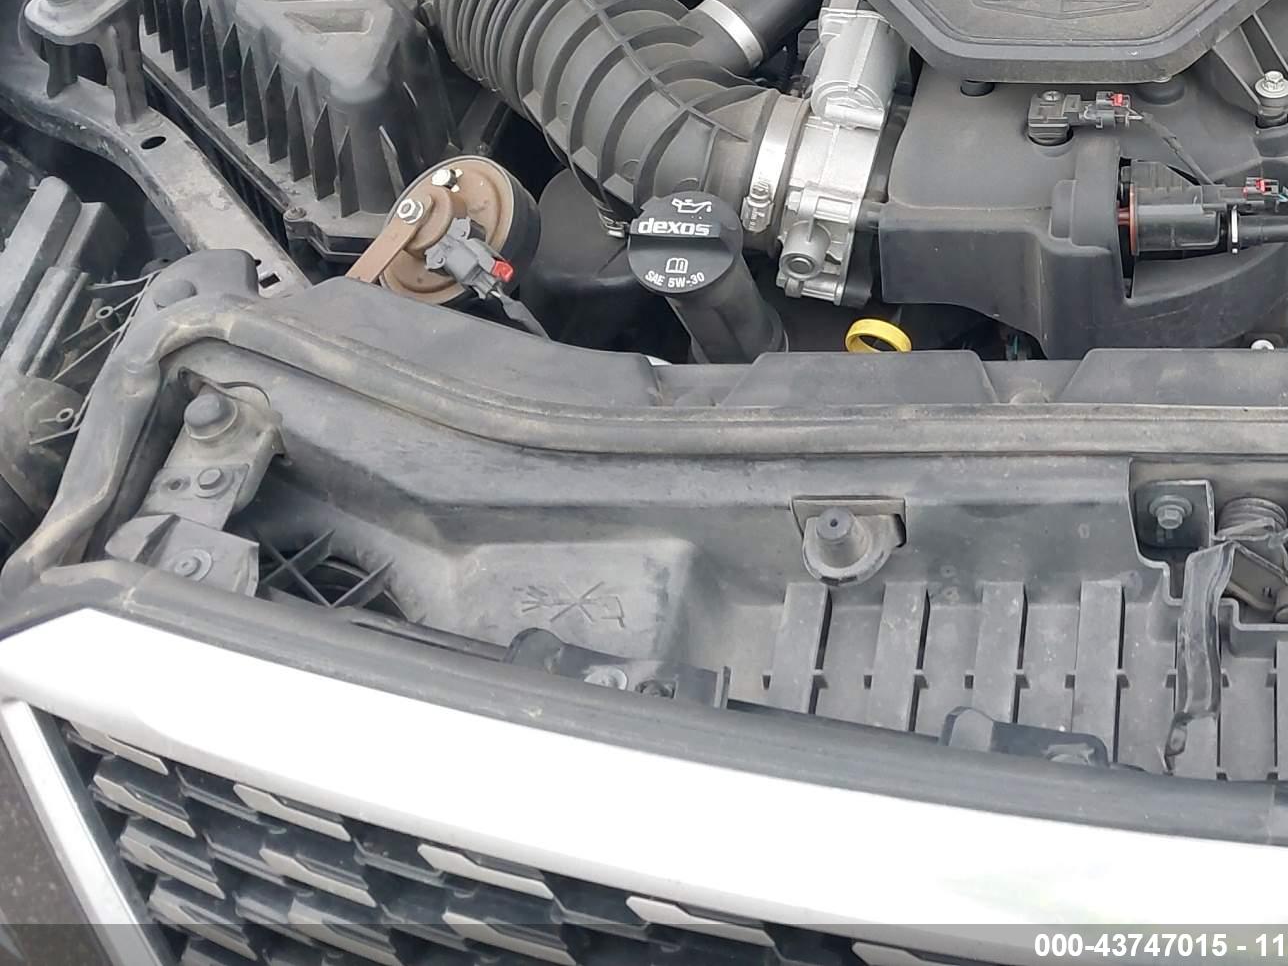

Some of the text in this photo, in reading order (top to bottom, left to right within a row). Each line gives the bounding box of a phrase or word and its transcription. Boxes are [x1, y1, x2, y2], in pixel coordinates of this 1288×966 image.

[637, 217, 713, 236] dexos
[644, 270, 705, 288] SAE 5W-30
